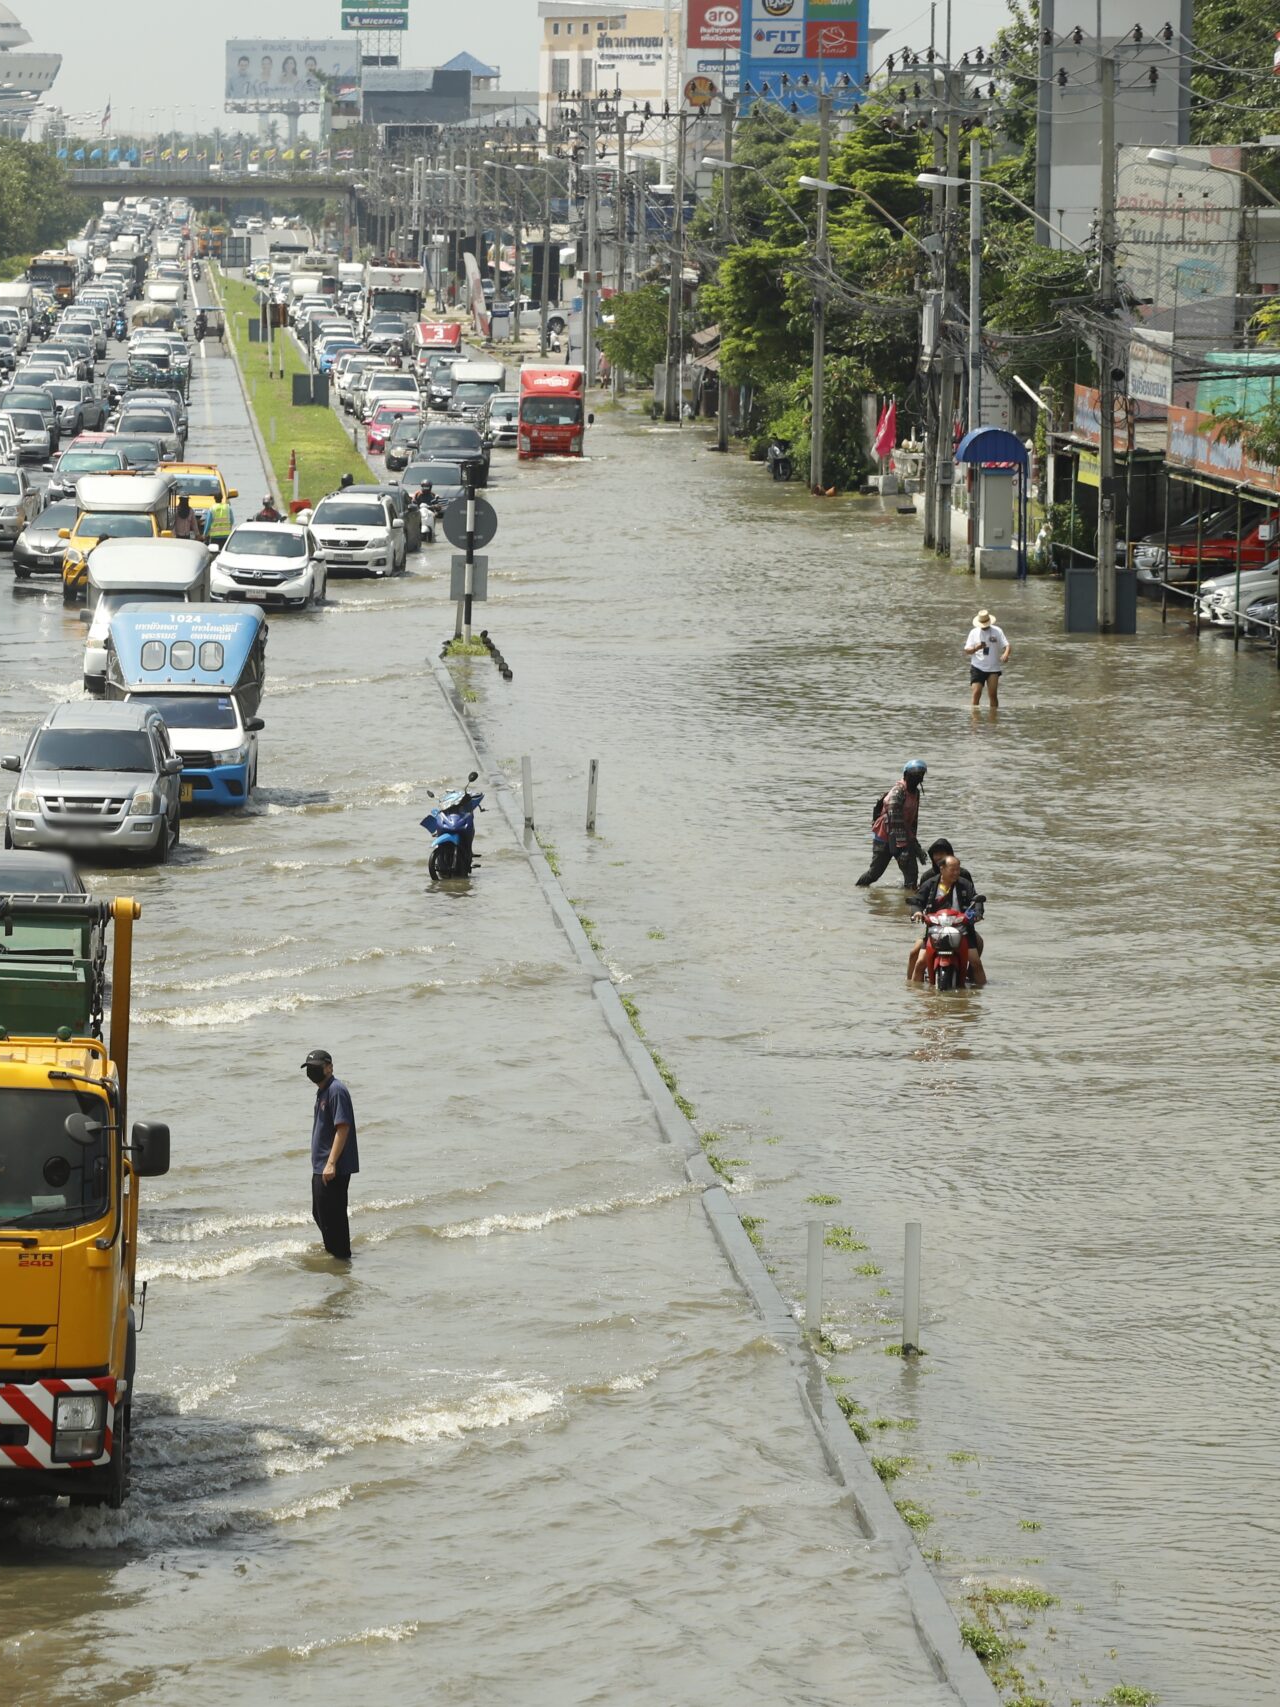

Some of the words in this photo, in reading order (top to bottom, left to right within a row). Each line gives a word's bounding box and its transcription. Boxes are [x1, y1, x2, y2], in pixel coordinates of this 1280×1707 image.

[708, 11, 737, 23] aro
[765, 30, 801, 42] FIT
[170, 615, 202, 623] 1024
